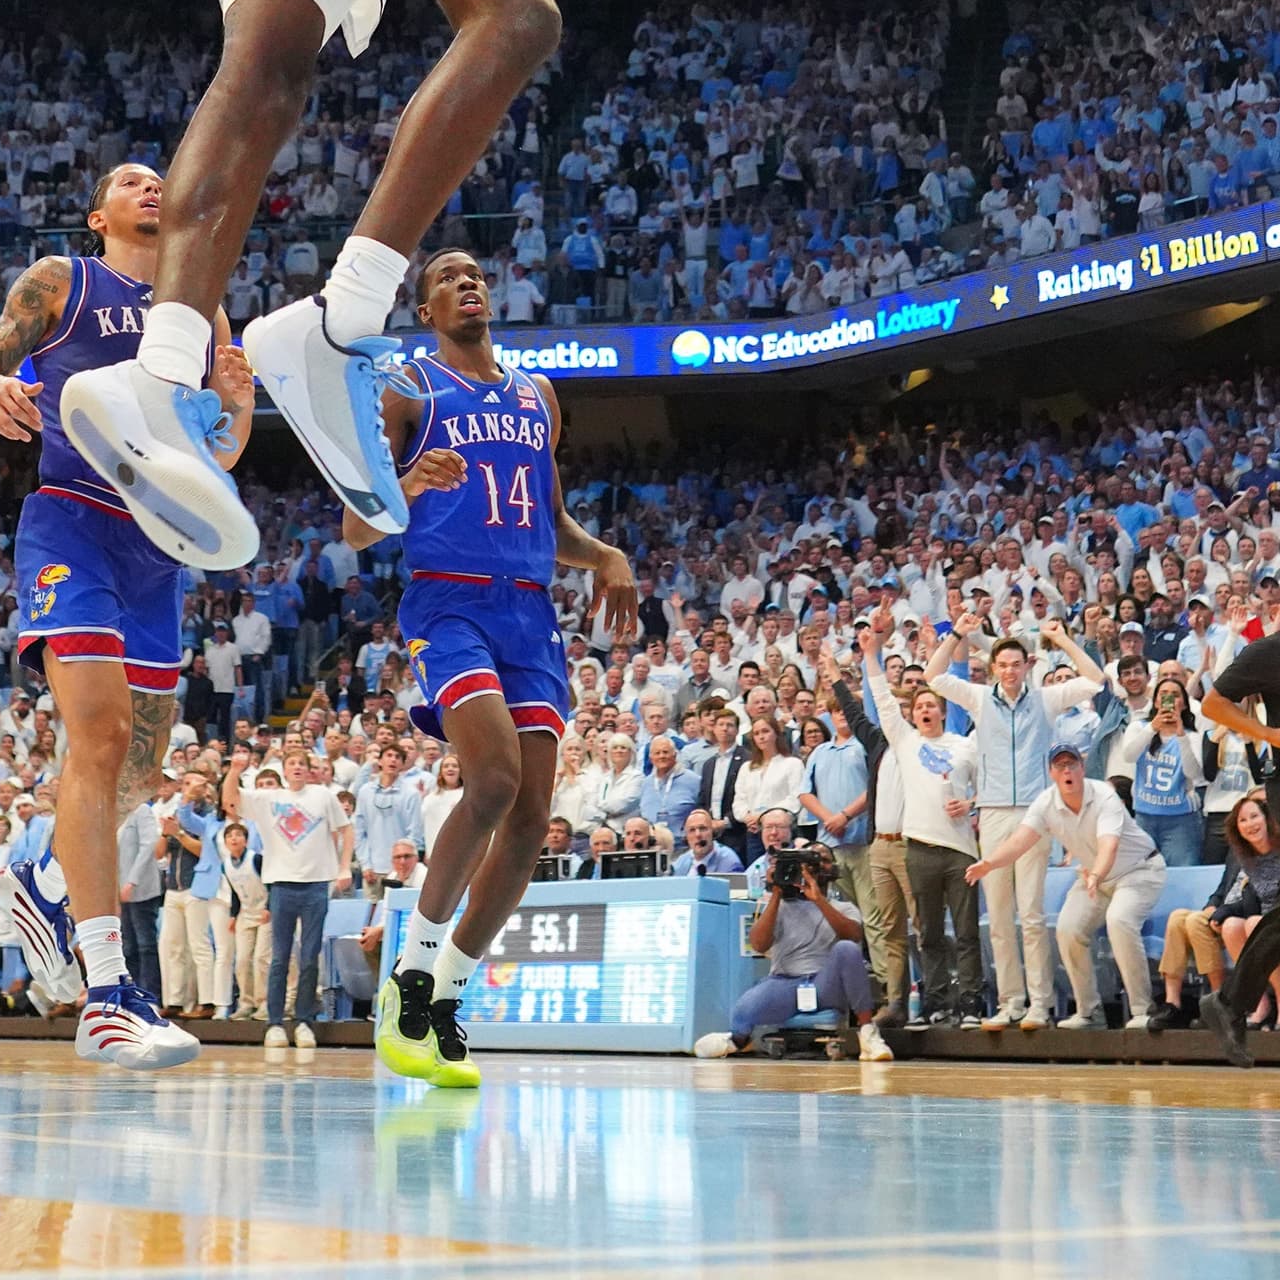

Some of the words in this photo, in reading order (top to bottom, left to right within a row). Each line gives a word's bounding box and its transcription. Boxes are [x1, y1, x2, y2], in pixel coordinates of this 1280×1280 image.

[1038, 257, 1134, 302] Raising
[1140, 248, 1163, 277] $1
[1168, 229, 1259, 270] Billion
[713, 335, 760, 363] NC
[761, 318, 875, 361] Education
[876, 298, 960, 338] Lottery
[493, 341, 618, 369] ducation
[442, 412, 546, 452] KANSAS
[477, 462, 536, 529] 14
[1144, 765, 1174, 792] 15
[529, 912, 579, 954] 55.1
[541, 991, 565, 1022] 13
[575, 991, 588, 1022] 5
